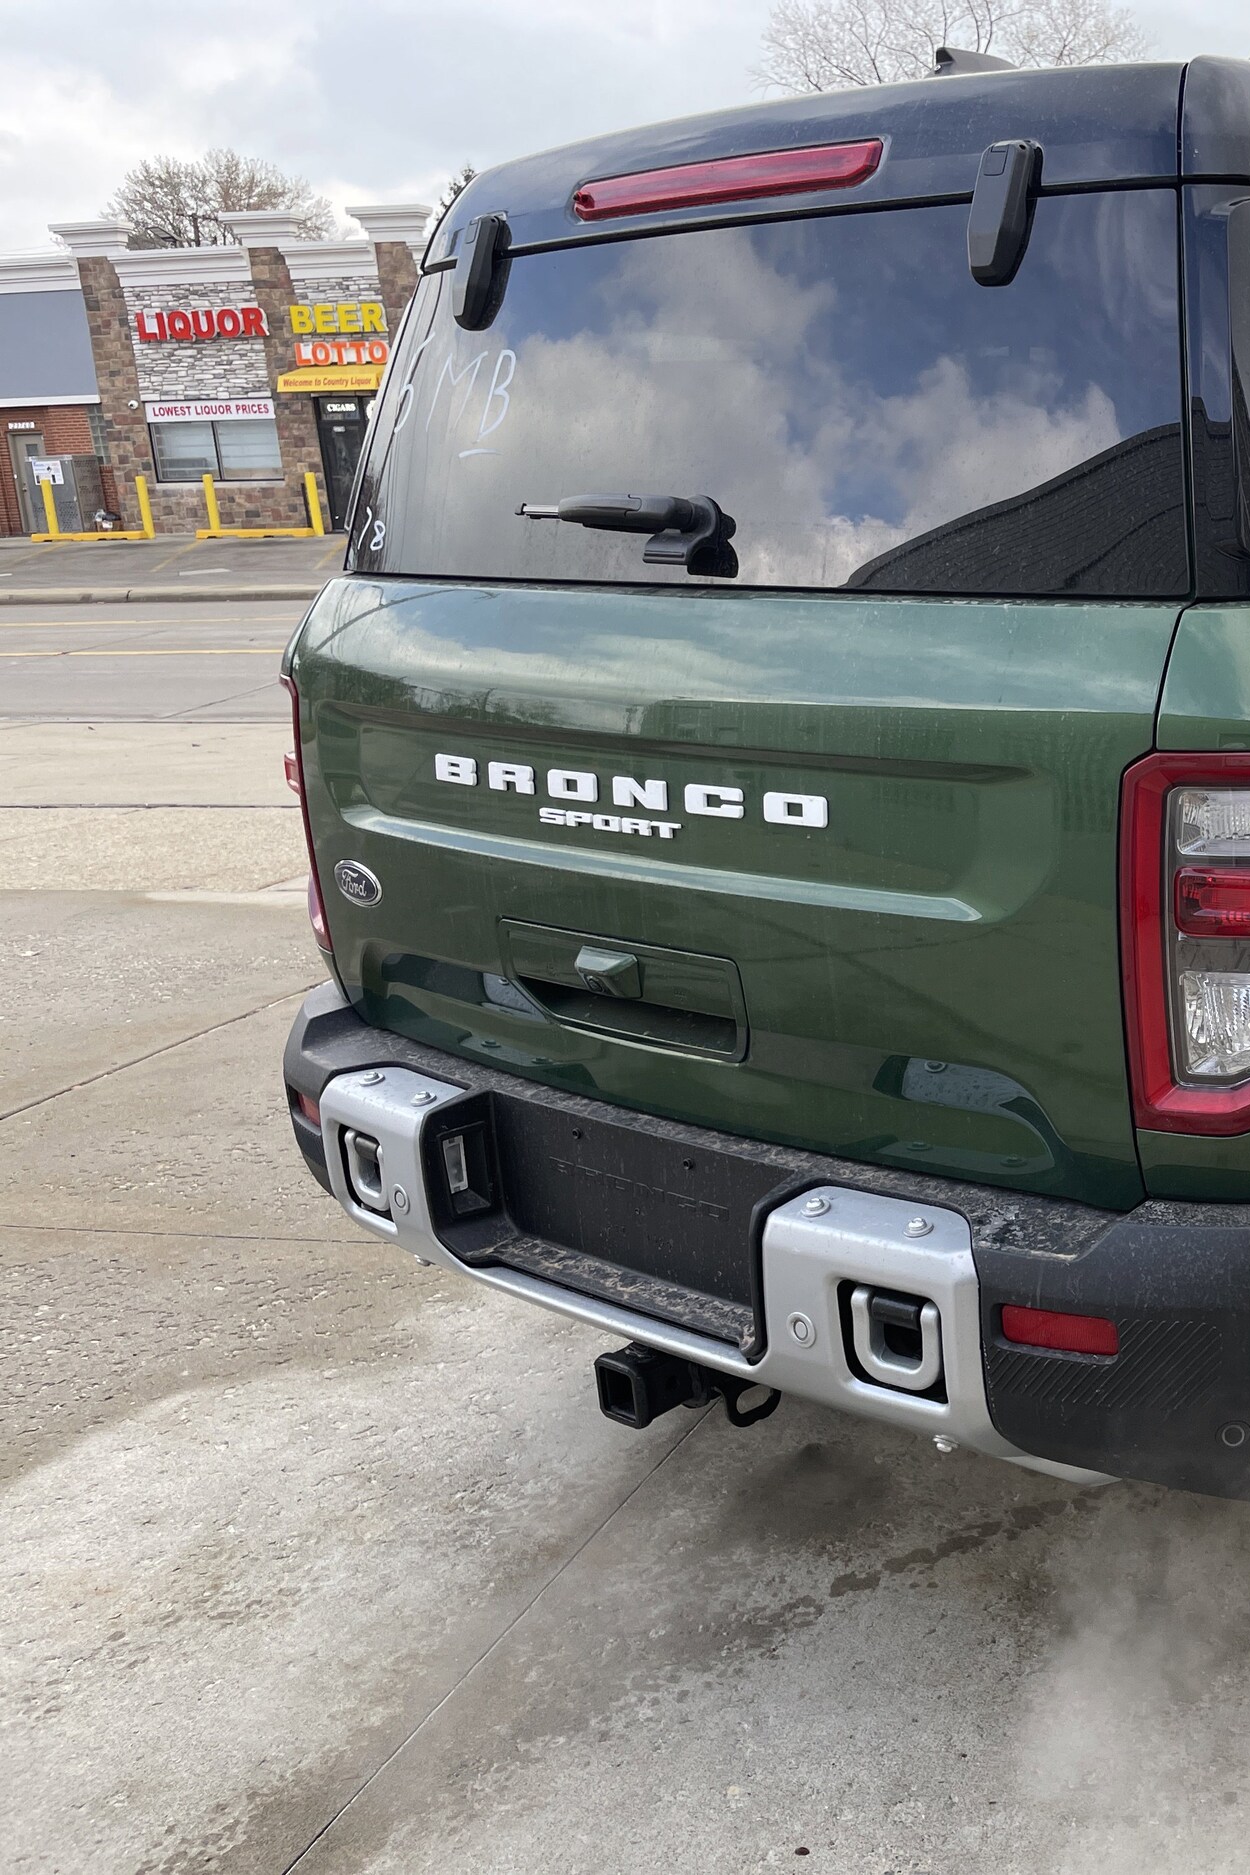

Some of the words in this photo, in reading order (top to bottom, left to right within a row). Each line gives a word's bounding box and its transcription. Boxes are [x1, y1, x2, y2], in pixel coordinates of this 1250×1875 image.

[137, 306, 268, 342] LIQUOR
[290, 302, 387, 334] BEER
[294, 340, 389, 366] LOTTO
[283, 378, 312, 387] Welcome
[322, 377, 349, 387] Country
[350, 377, 372, 387] Liquor
[152, 405, 192, 417] LOWEST
[194, 405, 233, 416] LIQUOR
[235, 403, 270, 415] PRICES
[326, 402, 356, 412] CIGARS
[434, 752, 829, 829] BRONCO
[539, 806, 683, 839] SPORT
[341, 868, 367, 897] Ford
